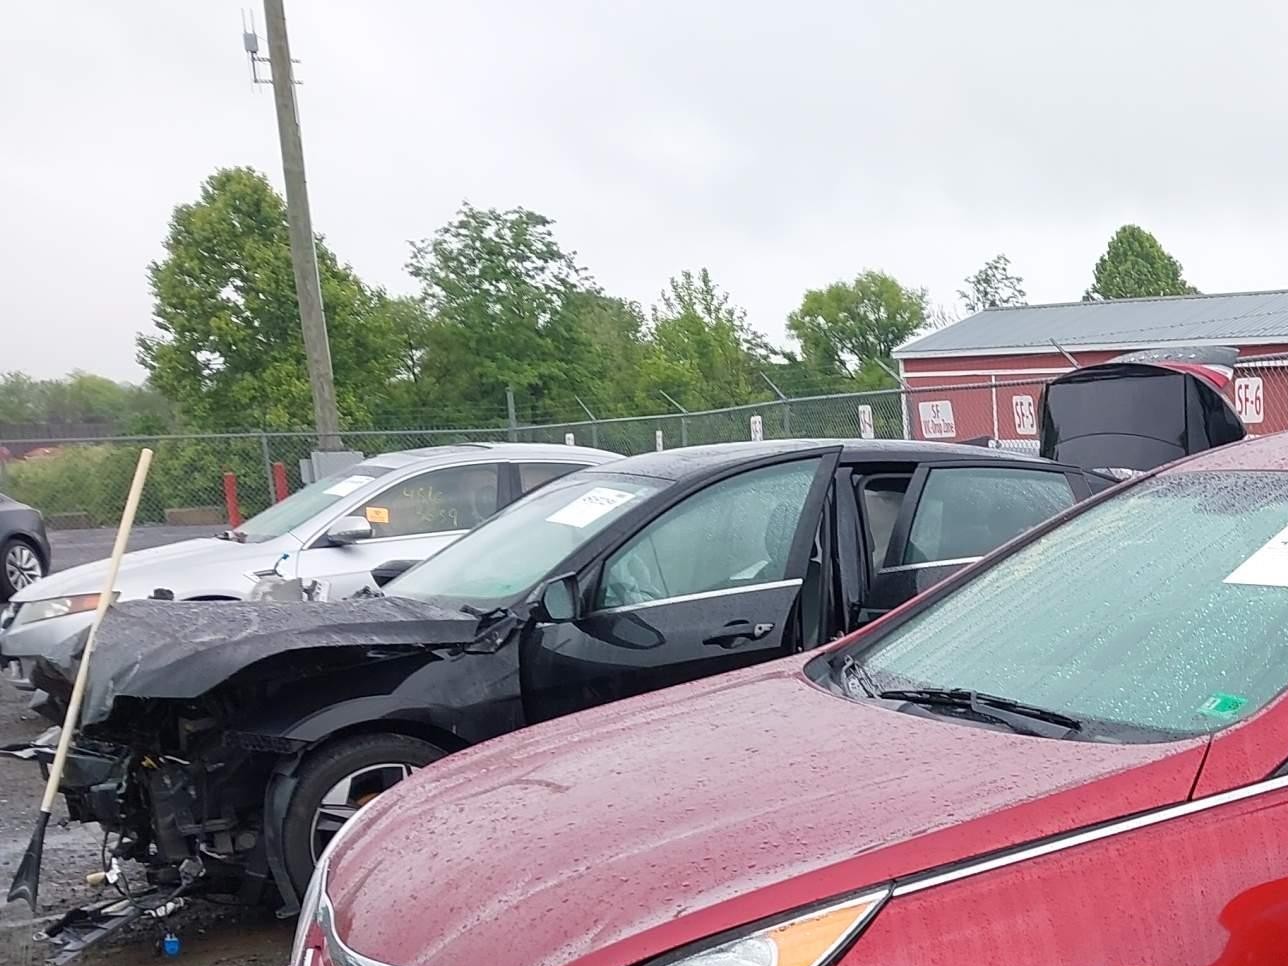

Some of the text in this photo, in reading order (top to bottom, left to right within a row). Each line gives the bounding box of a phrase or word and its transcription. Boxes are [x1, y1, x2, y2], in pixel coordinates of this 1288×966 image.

[931, 404, 940, 418] SF
[1237, 384, 1262, 416] SF-6
[1015, 401, 1036, 429] SF-5
